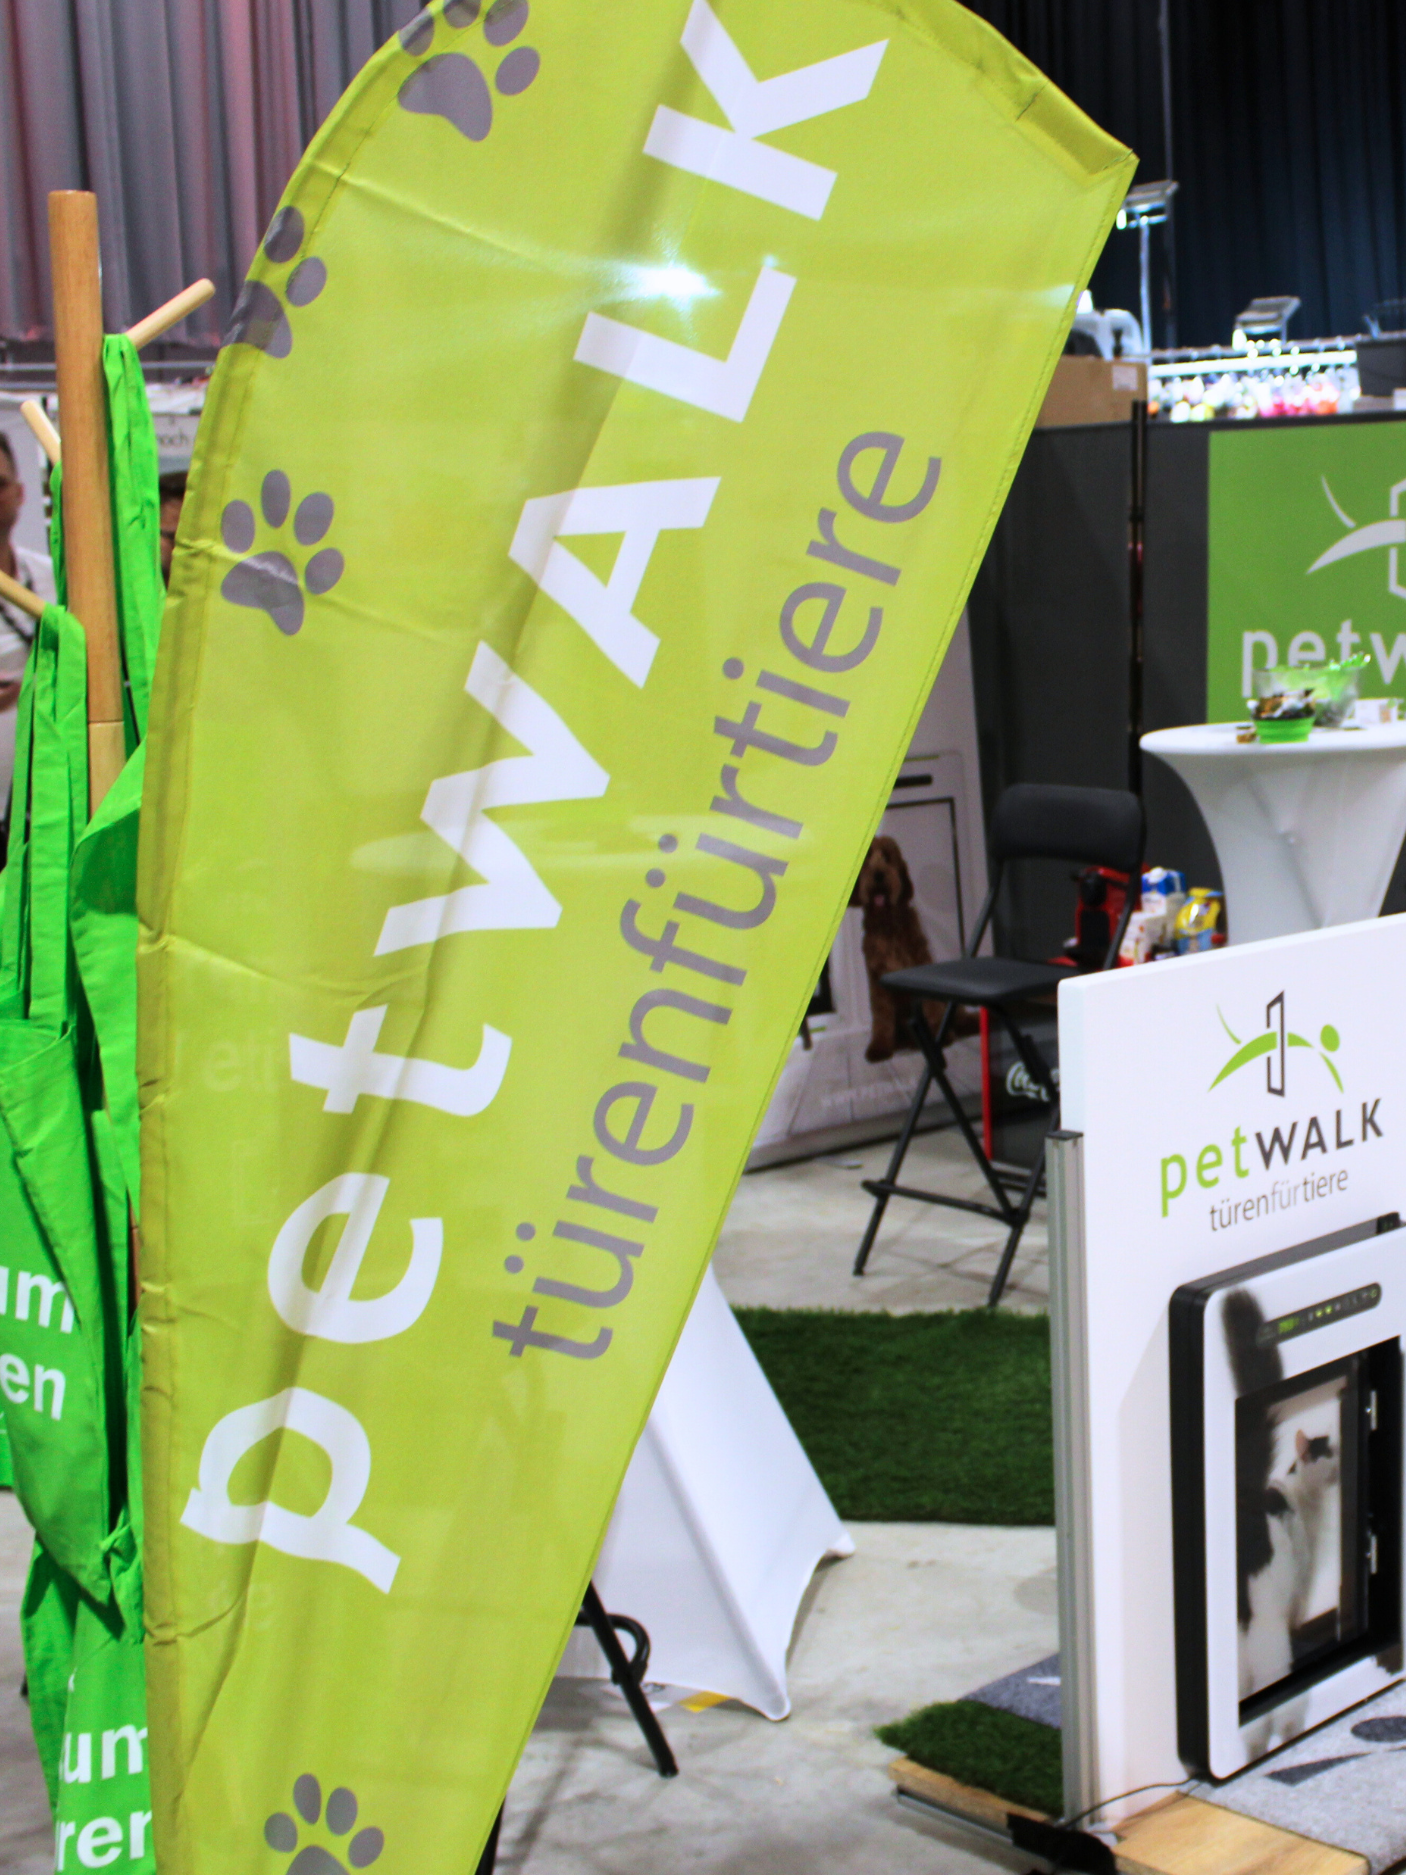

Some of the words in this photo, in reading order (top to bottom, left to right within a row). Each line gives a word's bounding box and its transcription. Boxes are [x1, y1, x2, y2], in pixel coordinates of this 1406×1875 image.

[181, 0, 888, 1593] petWALK
[491, 430, 942, 1360] türenfürtiere
[1160, 1098, 1383, 1218] petWALK
[1208, 1168, 1349, 1231] türenfürtiere
